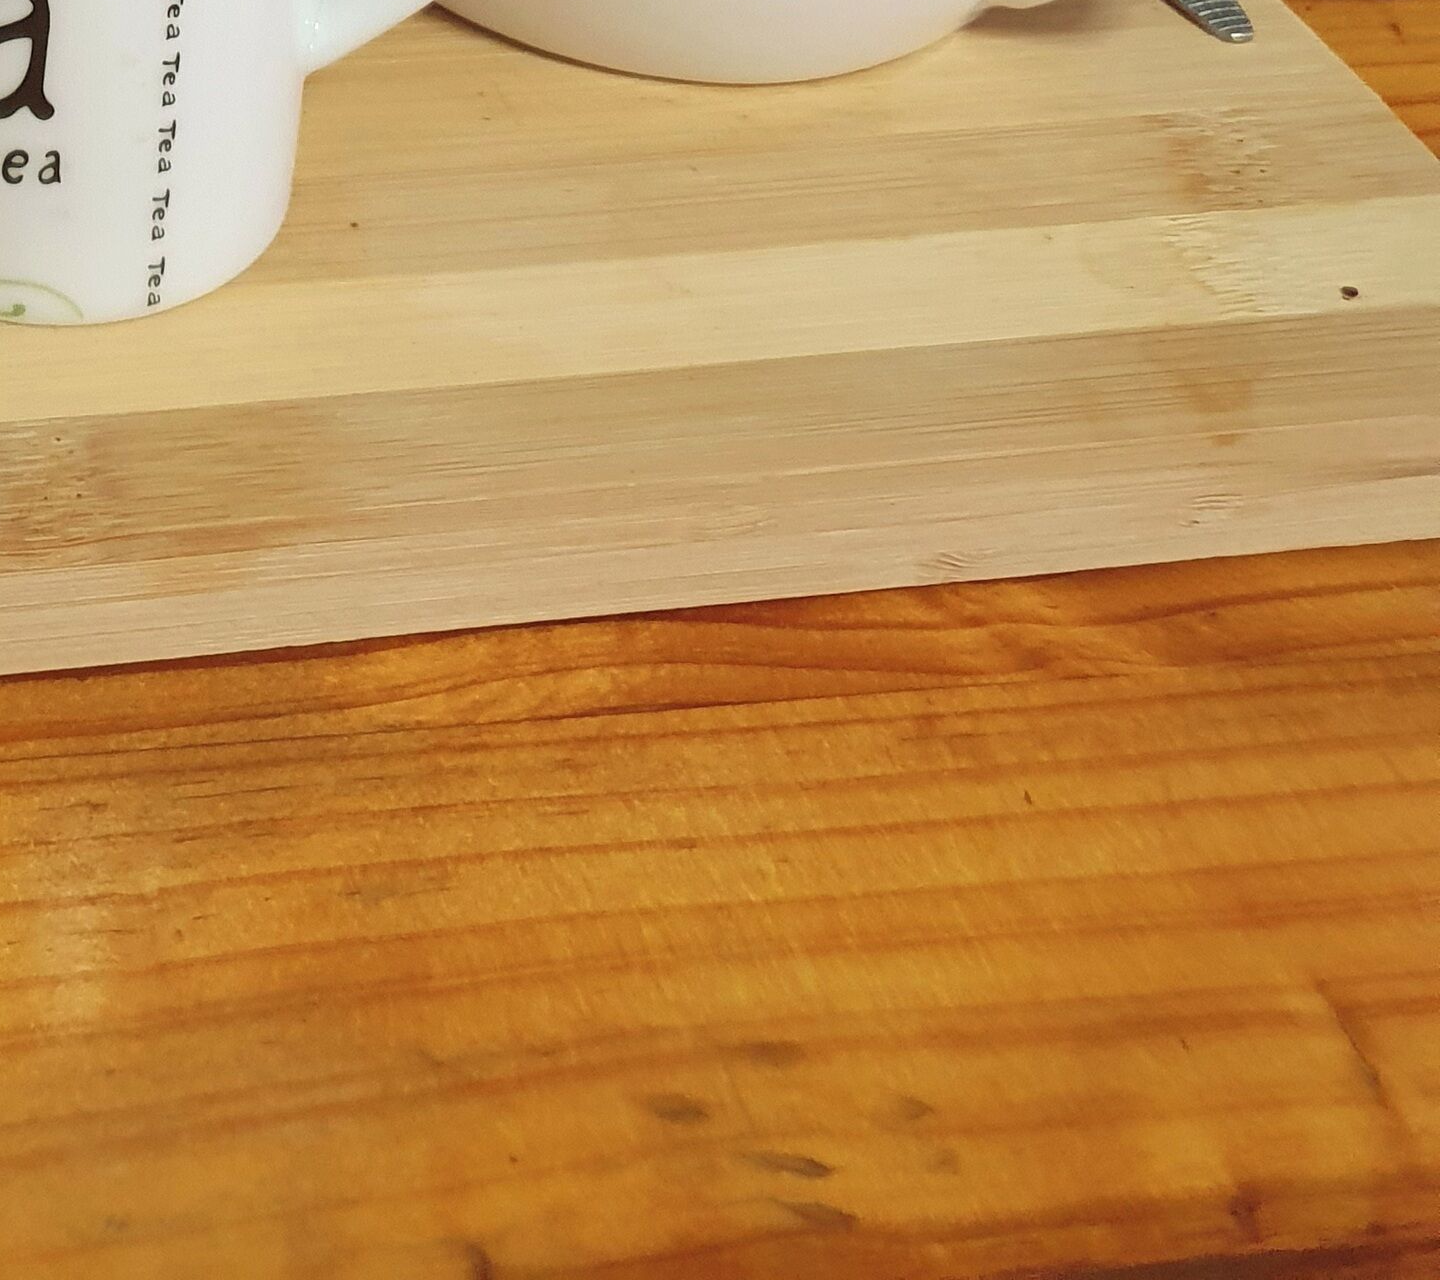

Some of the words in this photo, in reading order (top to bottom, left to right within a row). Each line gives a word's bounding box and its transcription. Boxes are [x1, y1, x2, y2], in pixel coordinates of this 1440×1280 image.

[161, 51, 180, 107] Tea
[157, 119, 176, 174] Tea
[151, 188, 170, 241] Tea
[147, 256, 165, 307] Tea
